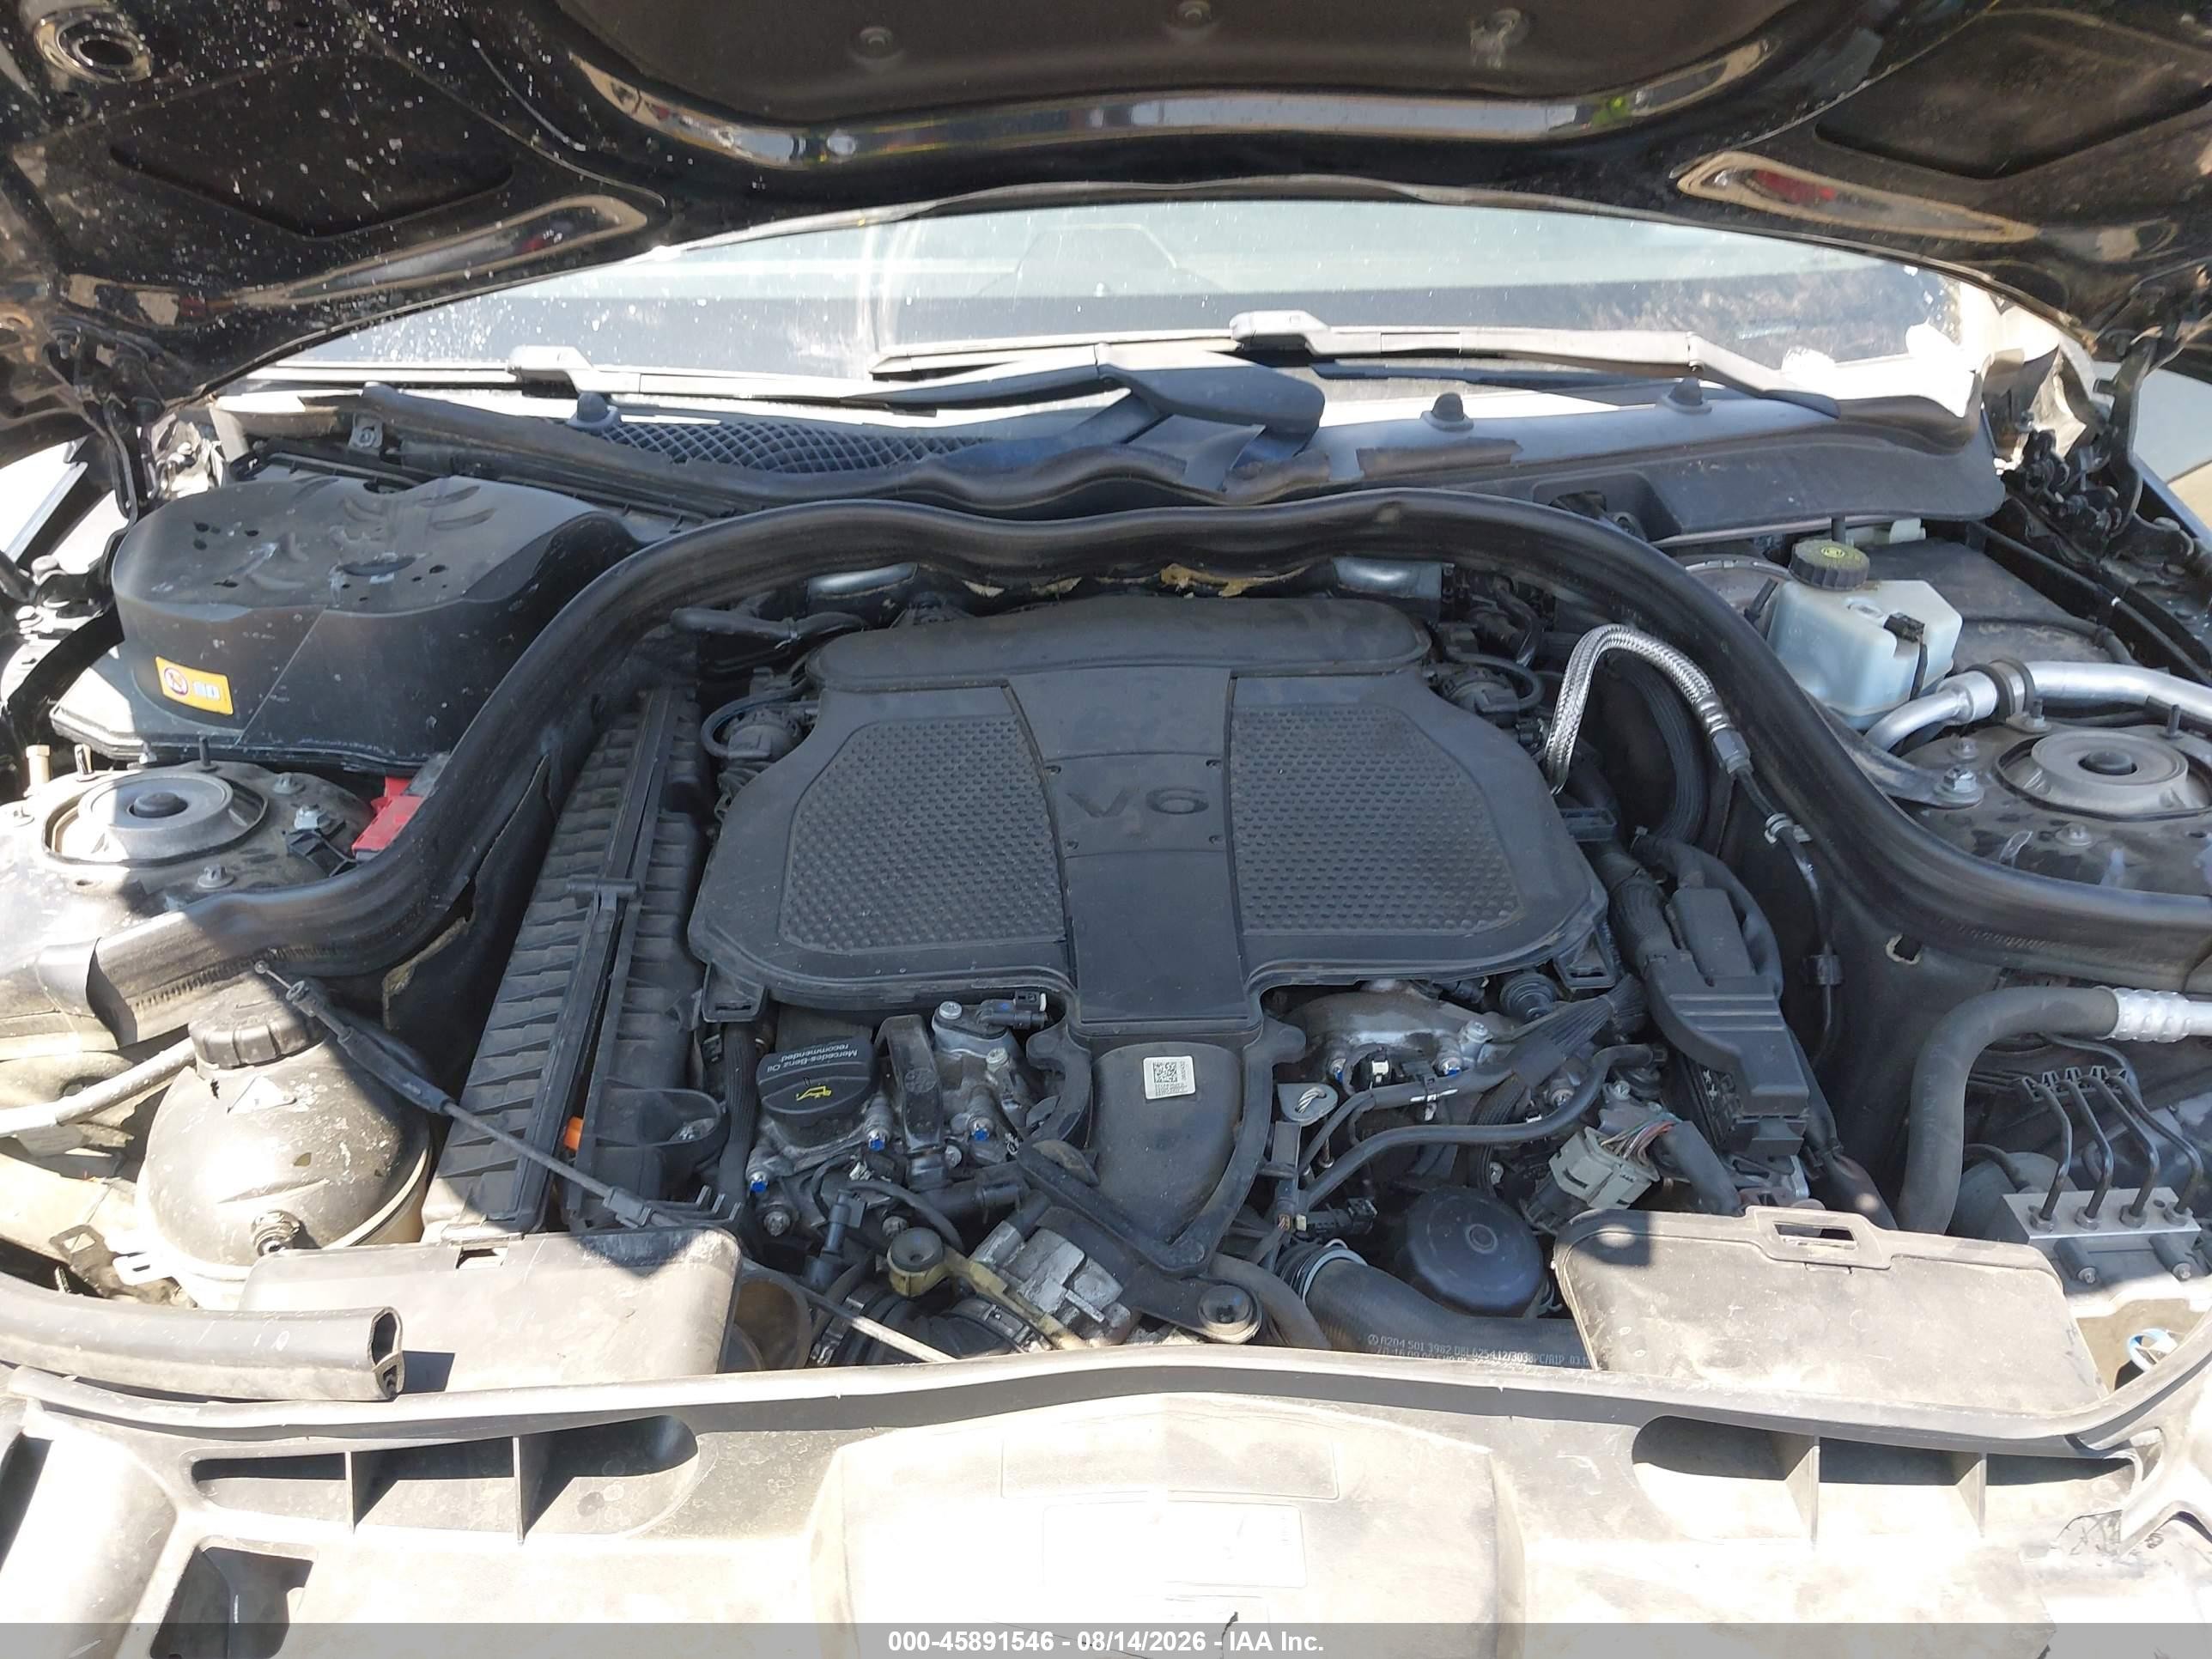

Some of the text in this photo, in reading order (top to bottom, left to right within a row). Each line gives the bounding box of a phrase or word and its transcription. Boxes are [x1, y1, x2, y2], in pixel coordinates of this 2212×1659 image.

[1066, 786, 1210, 818] V6
[767, 1049, 858, 1073] Mercedes-Benz Oil
